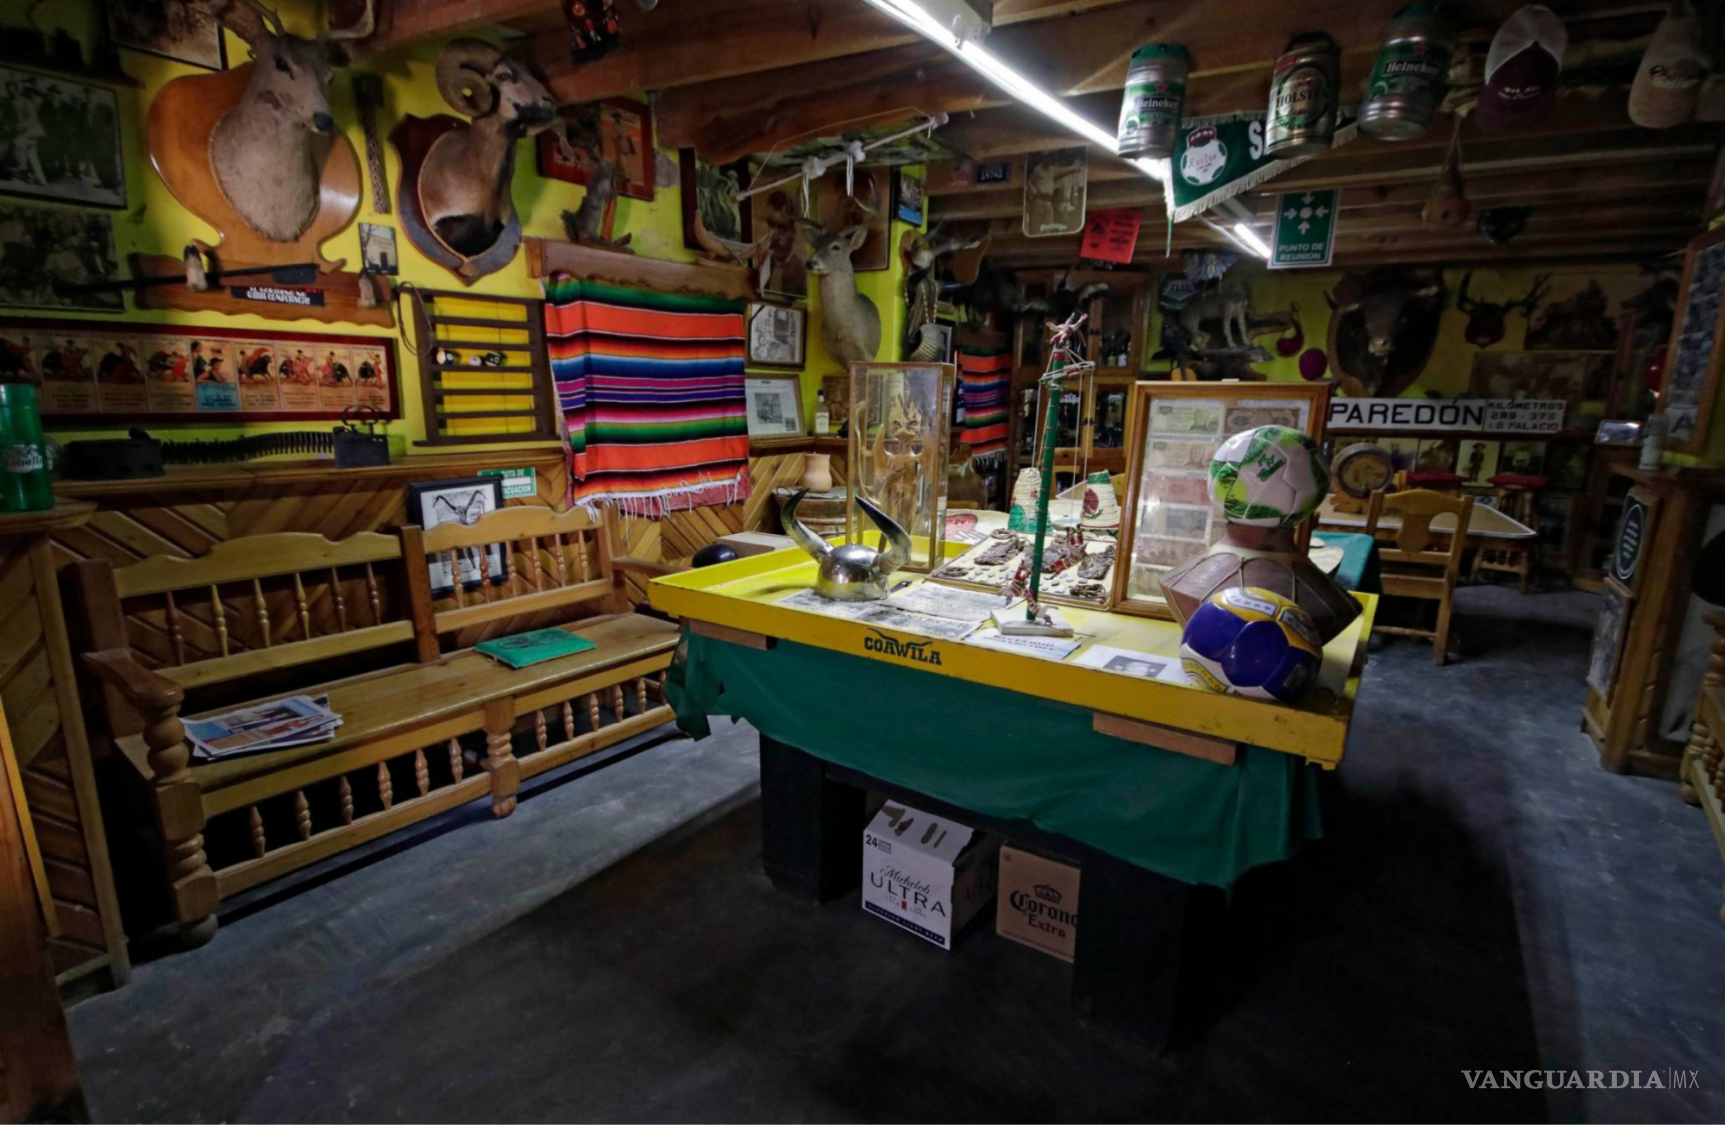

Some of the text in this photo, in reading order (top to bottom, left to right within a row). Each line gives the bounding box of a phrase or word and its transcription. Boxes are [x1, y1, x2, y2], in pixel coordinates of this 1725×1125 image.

[1137, 97, 1179, 109] Heineken
[1276, 89, 1329, 108] HOLSTE
[1279, 242, 1325, 252] PUNTO DE
[1328, 399, 1484, 426] PAREDÓN
[1508, 422, 1559, 431] PALACIO
[502, 485, 531, 495] ACUACION
[864, 636, 942, 666] COAWILA
[865, 834, 878, 848] 24
[880, 865, 931, 895] Michelob
[871, 872, 946, 918] ULTRA
[1028, 913, 1066, 938] Extra
[925, 930, 944, 943] BEER
